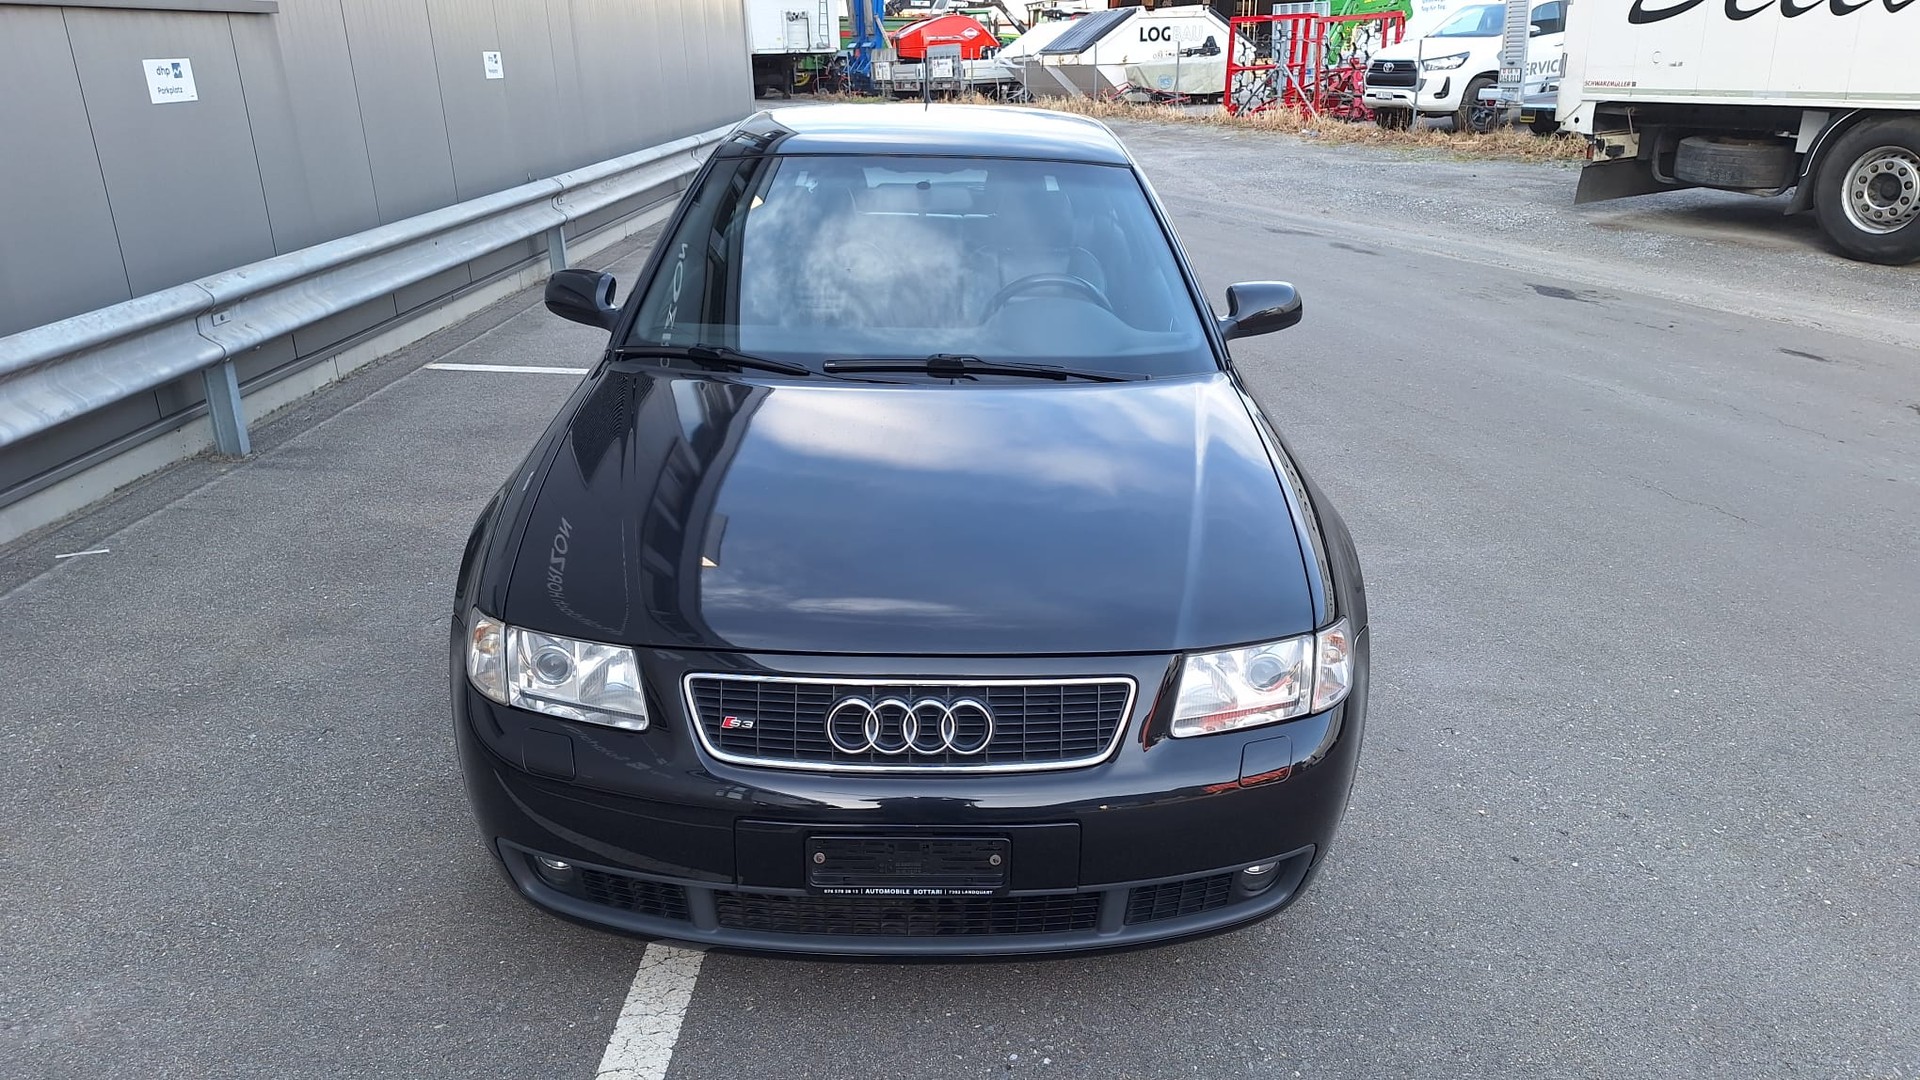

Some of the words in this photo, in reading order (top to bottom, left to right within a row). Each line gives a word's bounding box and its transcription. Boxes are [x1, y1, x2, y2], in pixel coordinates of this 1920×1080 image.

[156, 65, 171, 78] dhp
[157, 86, 183, 95] Parkplatz
[727, 718, 754, 729] S3
